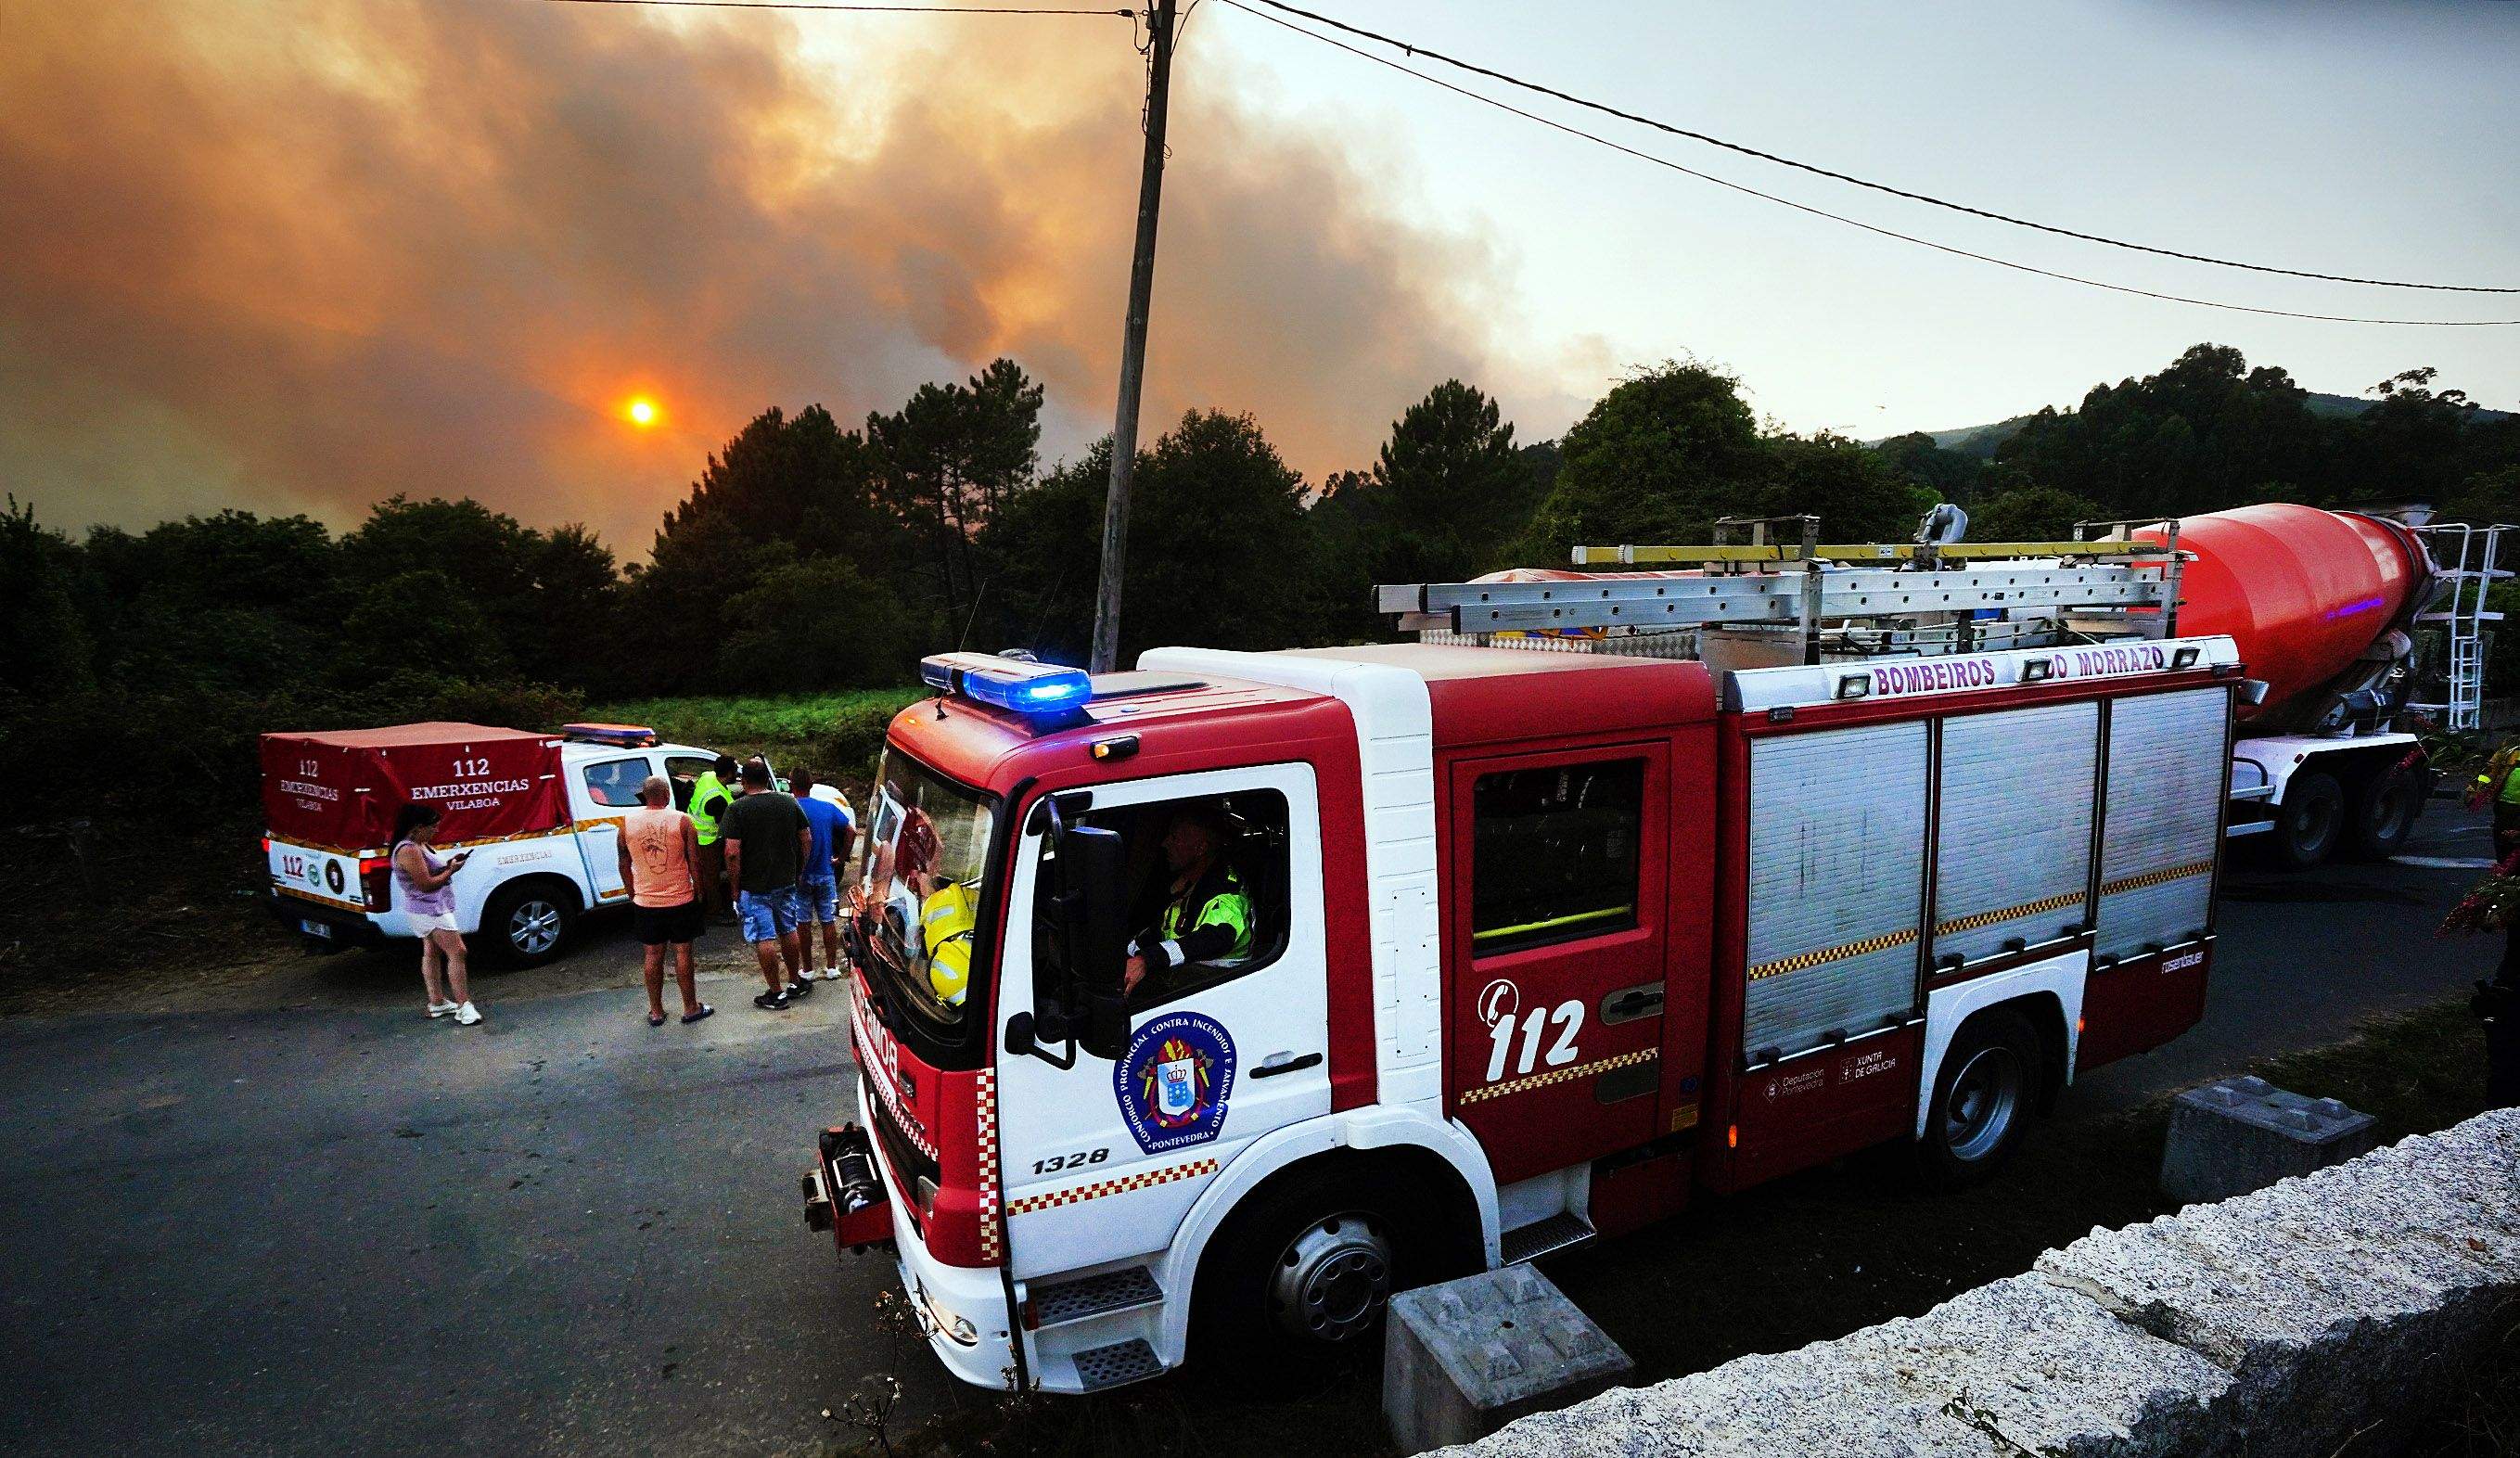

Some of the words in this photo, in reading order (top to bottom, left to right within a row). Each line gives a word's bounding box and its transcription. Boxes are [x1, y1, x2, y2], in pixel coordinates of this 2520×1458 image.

[1874, 659, 1995, 695] BOMBEIROS
[2076, 646, 2165, 677] MORRAZO
[299, 759, 319, 777] 112
[453, 758, 491, 777] 112
[411, 778, 530, 799] EMERXENCIAS
[446, 797, 501, 812] VILABOA
[282, 853, 304, 878] 112
[1150, 1017, 1189, 1035] CONTRA
[1192, 1018, 1231, 1054] INCENDIOS
[1486, 999, 1585, 1082] 112
[1119, 1033, 1149, 1092] PROVINCIAL
[1855, 1068, 1866, 1079] DE
[1865, 1058, 1896, 1075] GALICIA
[1856, 1051, 1883, 1068] XUNTA
[1211, 1068, 1232, 1128] SALVAMENTO
[1122, 1094, 1151, 1143] CONSORCIO
[1151, 1131, 1209, 1151] PONTEVEDRA
[1031, 1147, 1110, 1175] 1328
